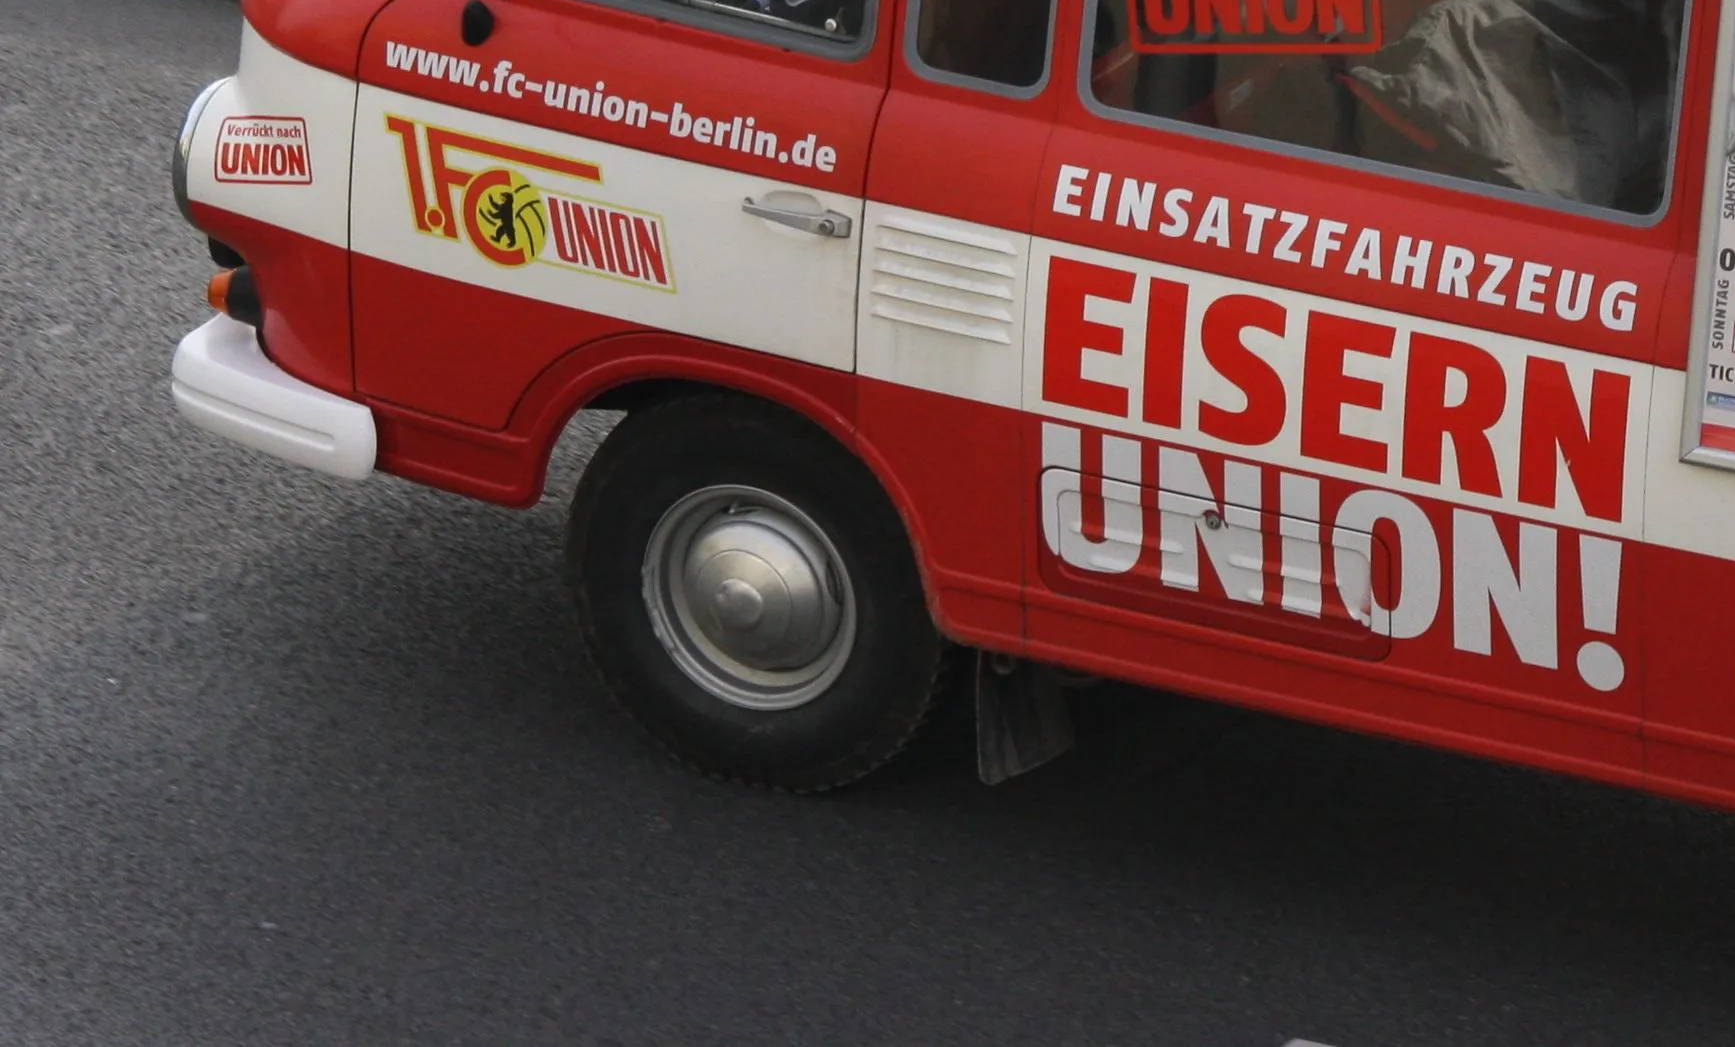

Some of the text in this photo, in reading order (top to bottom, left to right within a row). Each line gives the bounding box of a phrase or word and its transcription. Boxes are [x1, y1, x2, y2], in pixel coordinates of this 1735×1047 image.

[221, 143, 306, 176] UNION
[227, 123, 301, 138] Verrückt nach
[386, 40, 836, 173] www.fc-union-berlin.de
[547, 197, 668, 287] UNION
[1052, 163, 1638, 332] EINSATZFAHRZEUG
[1712, 279, 1730, 350] SONNTAG
[1041, 254, 1632, 523] EISERN
[1041, 421, 1626, 691] UNION!
